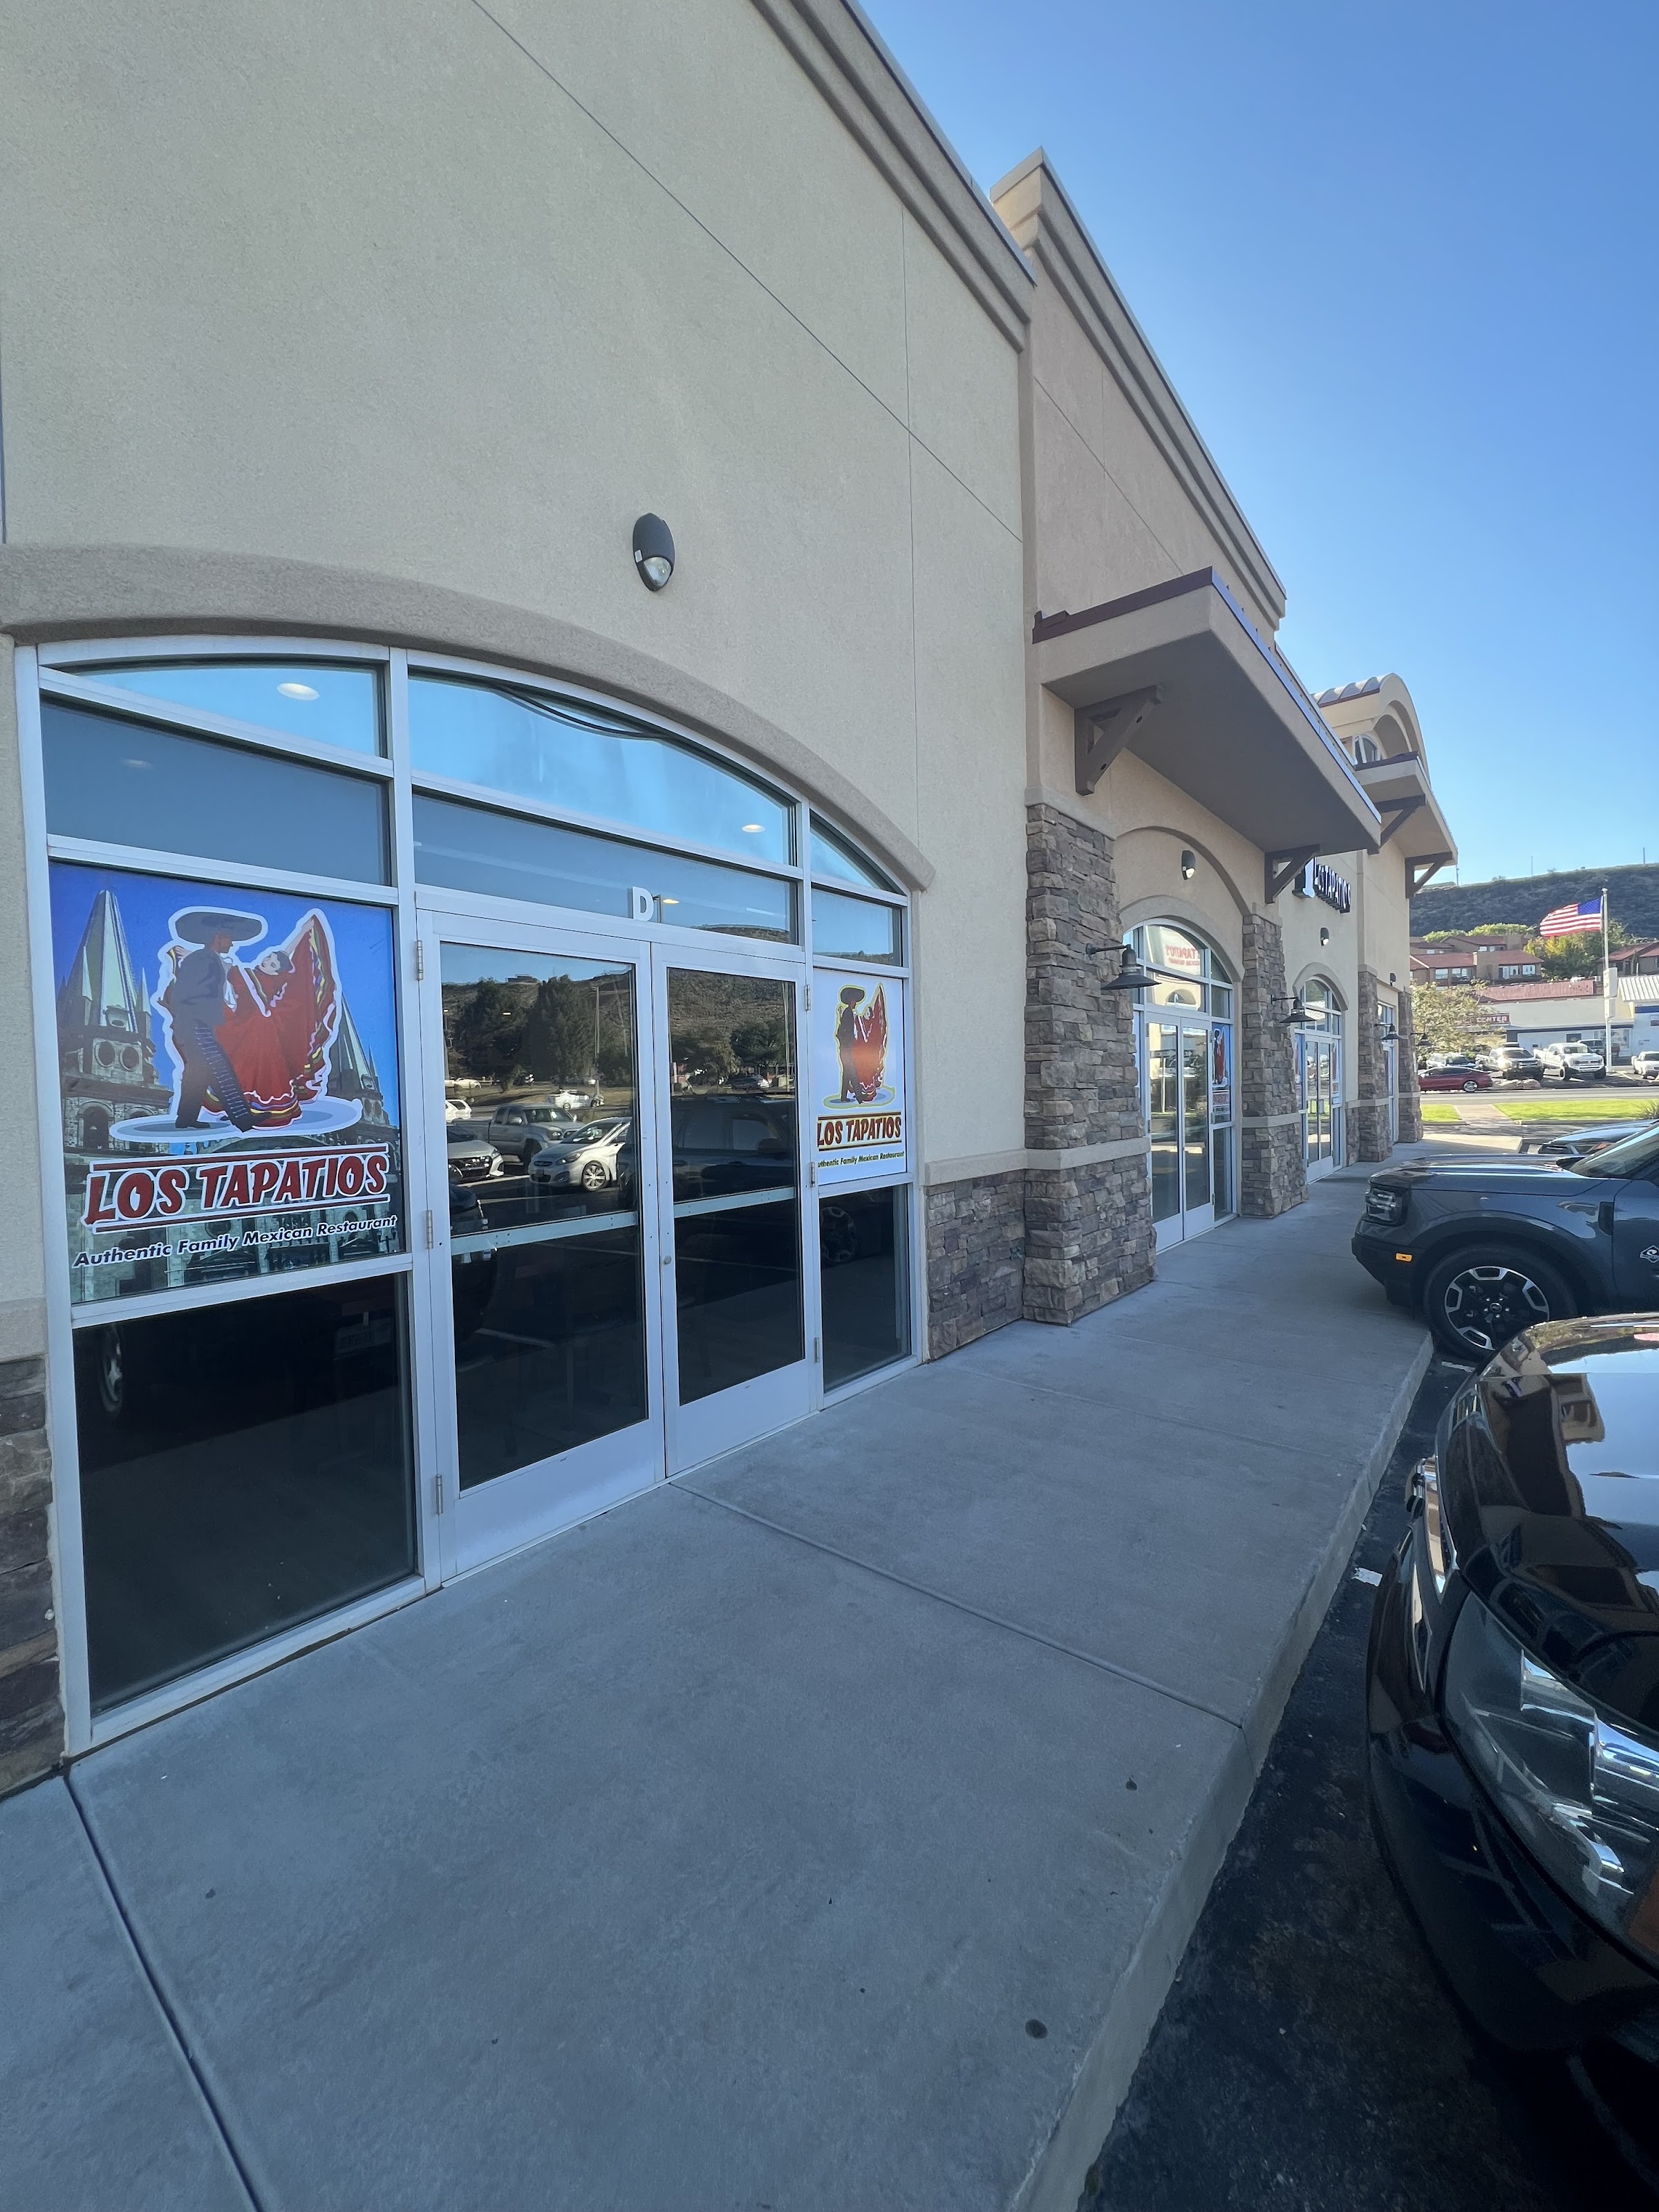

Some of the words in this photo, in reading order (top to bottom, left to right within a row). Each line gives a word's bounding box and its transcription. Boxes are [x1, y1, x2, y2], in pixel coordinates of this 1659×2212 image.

[632, 886, 654, 921] D
[817, 1121, 843, 1147] LOS
[845, 1116, 902, 1143] TAPATIOS
[818, 1159, 839, 1168] uthentic
[840, 1155, 858, 1165] Family
[859, 1154, 879, 1163] Mexican
[879, 1150, 904, 1160] Restaurant
[84, 1168, 187, 1226] LOS
[198, 1154, 388, 1209] TAPATIOS
[73, 1243, 171, 1267] Authentic
[178, 1233, 239, 1254] Family
[243, 1228, 313, 1246] Mexican
[317, 1215, 397, 1236] Restaurant
